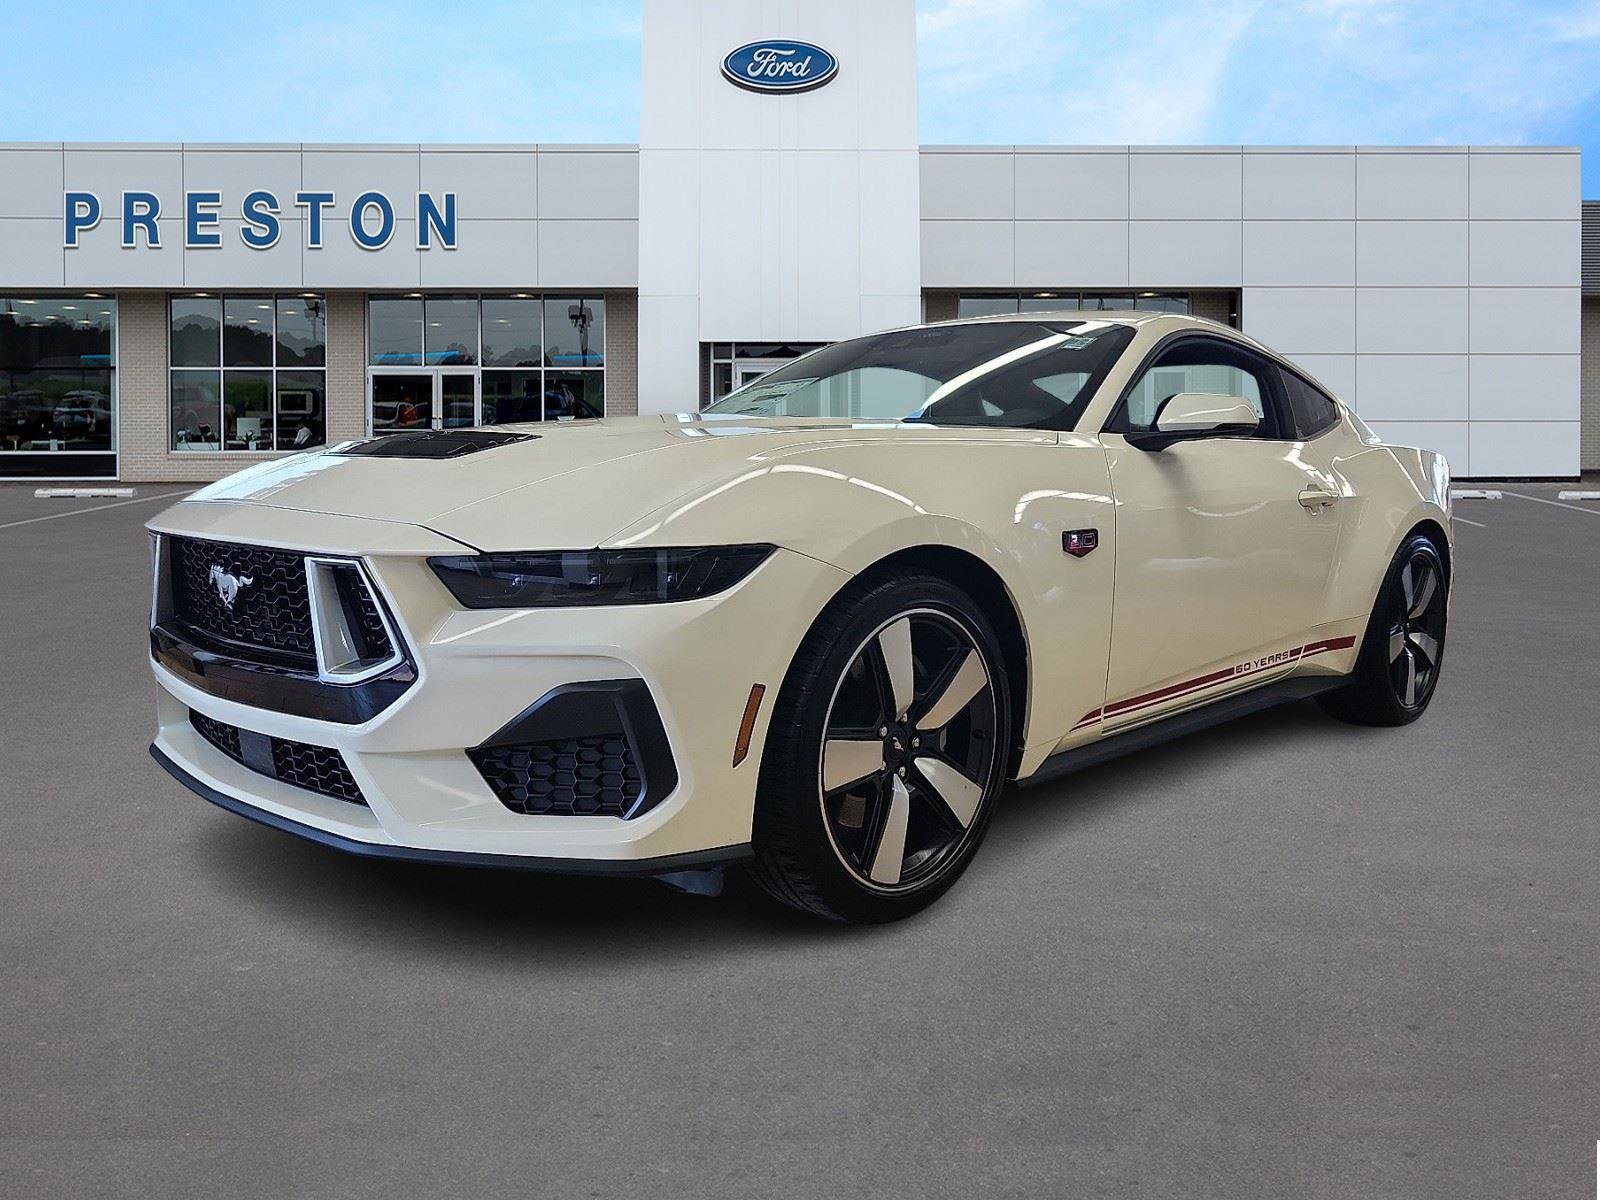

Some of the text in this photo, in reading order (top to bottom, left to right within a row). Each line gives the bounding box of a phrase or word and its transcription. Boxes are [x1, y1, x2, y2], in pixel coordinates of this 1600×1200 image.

[747, 48, 812, 77] Ford
[63, 190, 457, 250] PRESTON
[1253, 651, 1289, 668] YEARS
